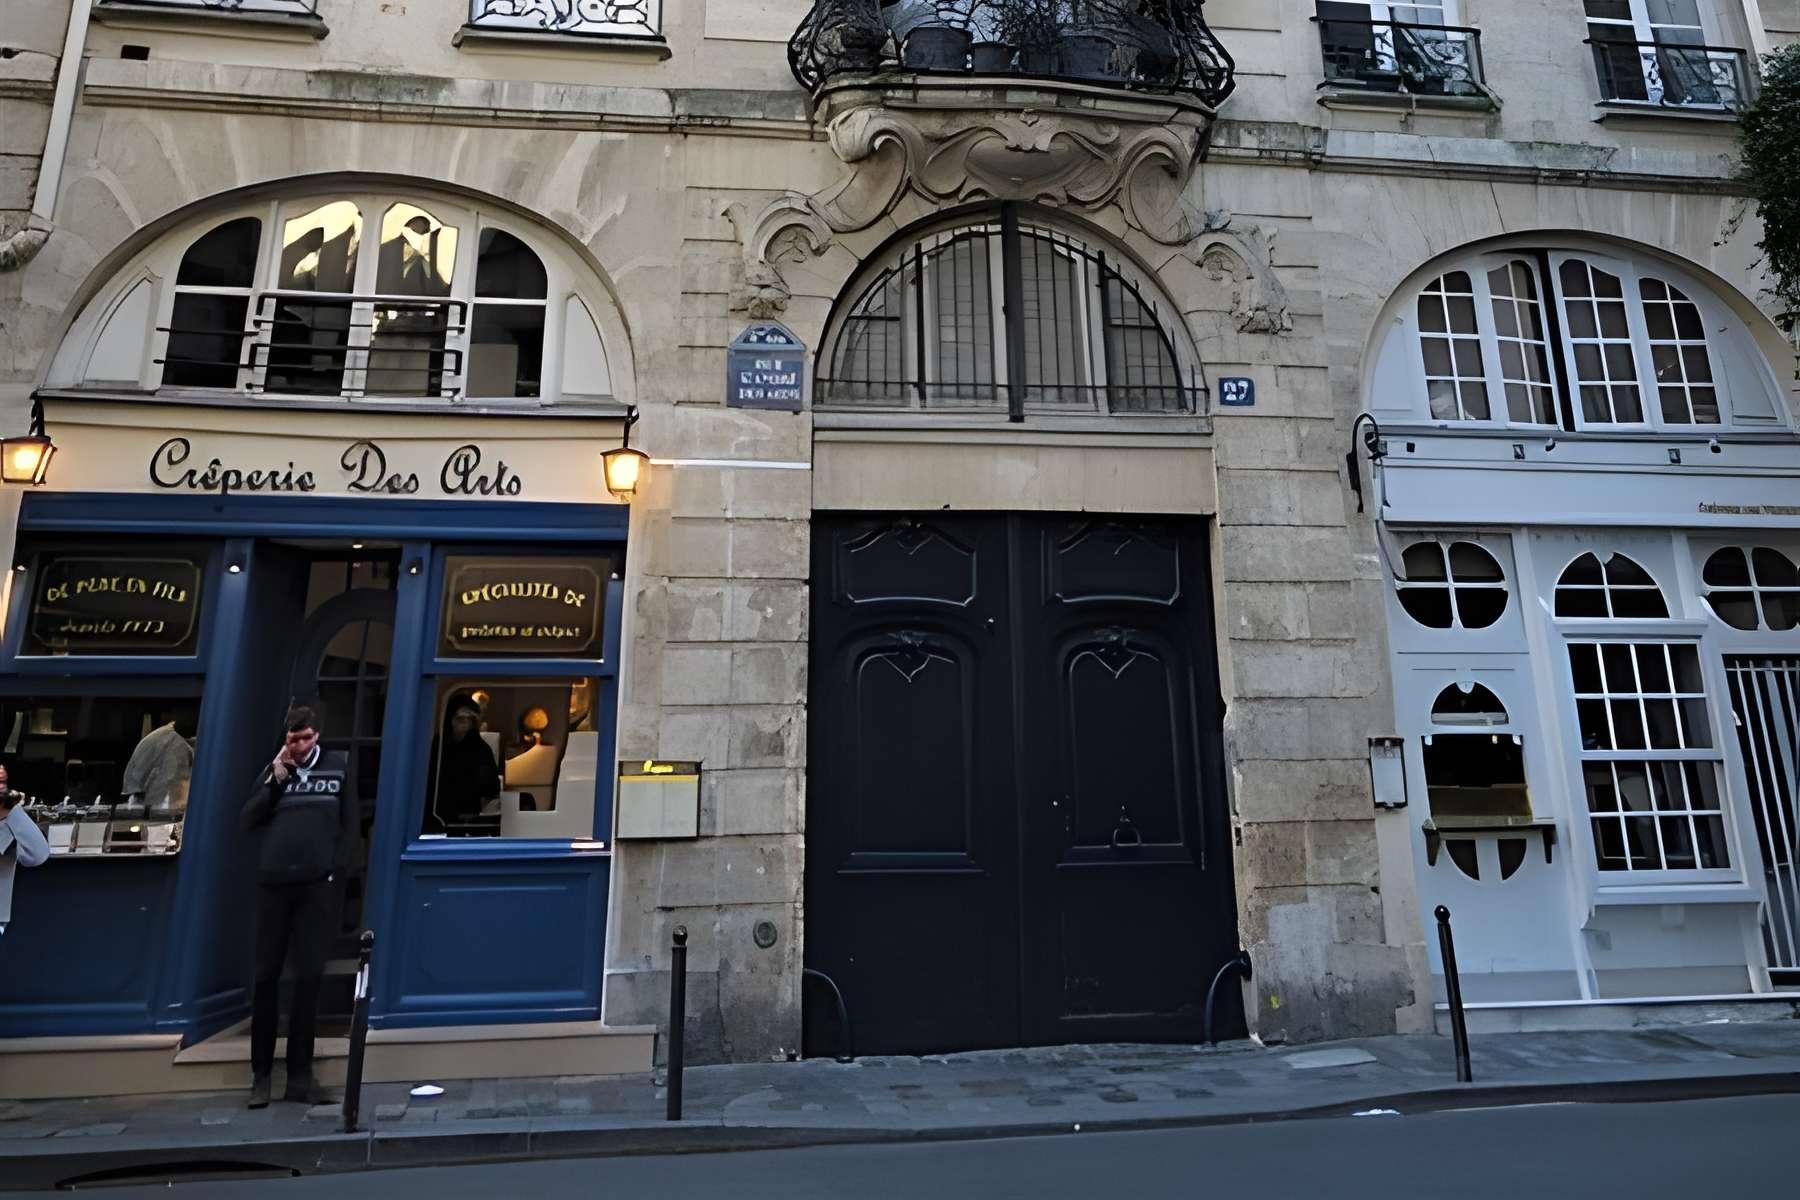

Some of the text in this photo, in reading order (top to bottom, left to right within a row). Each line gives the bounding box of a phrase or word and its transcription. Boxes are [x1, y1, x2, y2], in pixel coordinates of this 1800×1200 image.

[149, 437, 522, 496] Crêperie Des Arts
